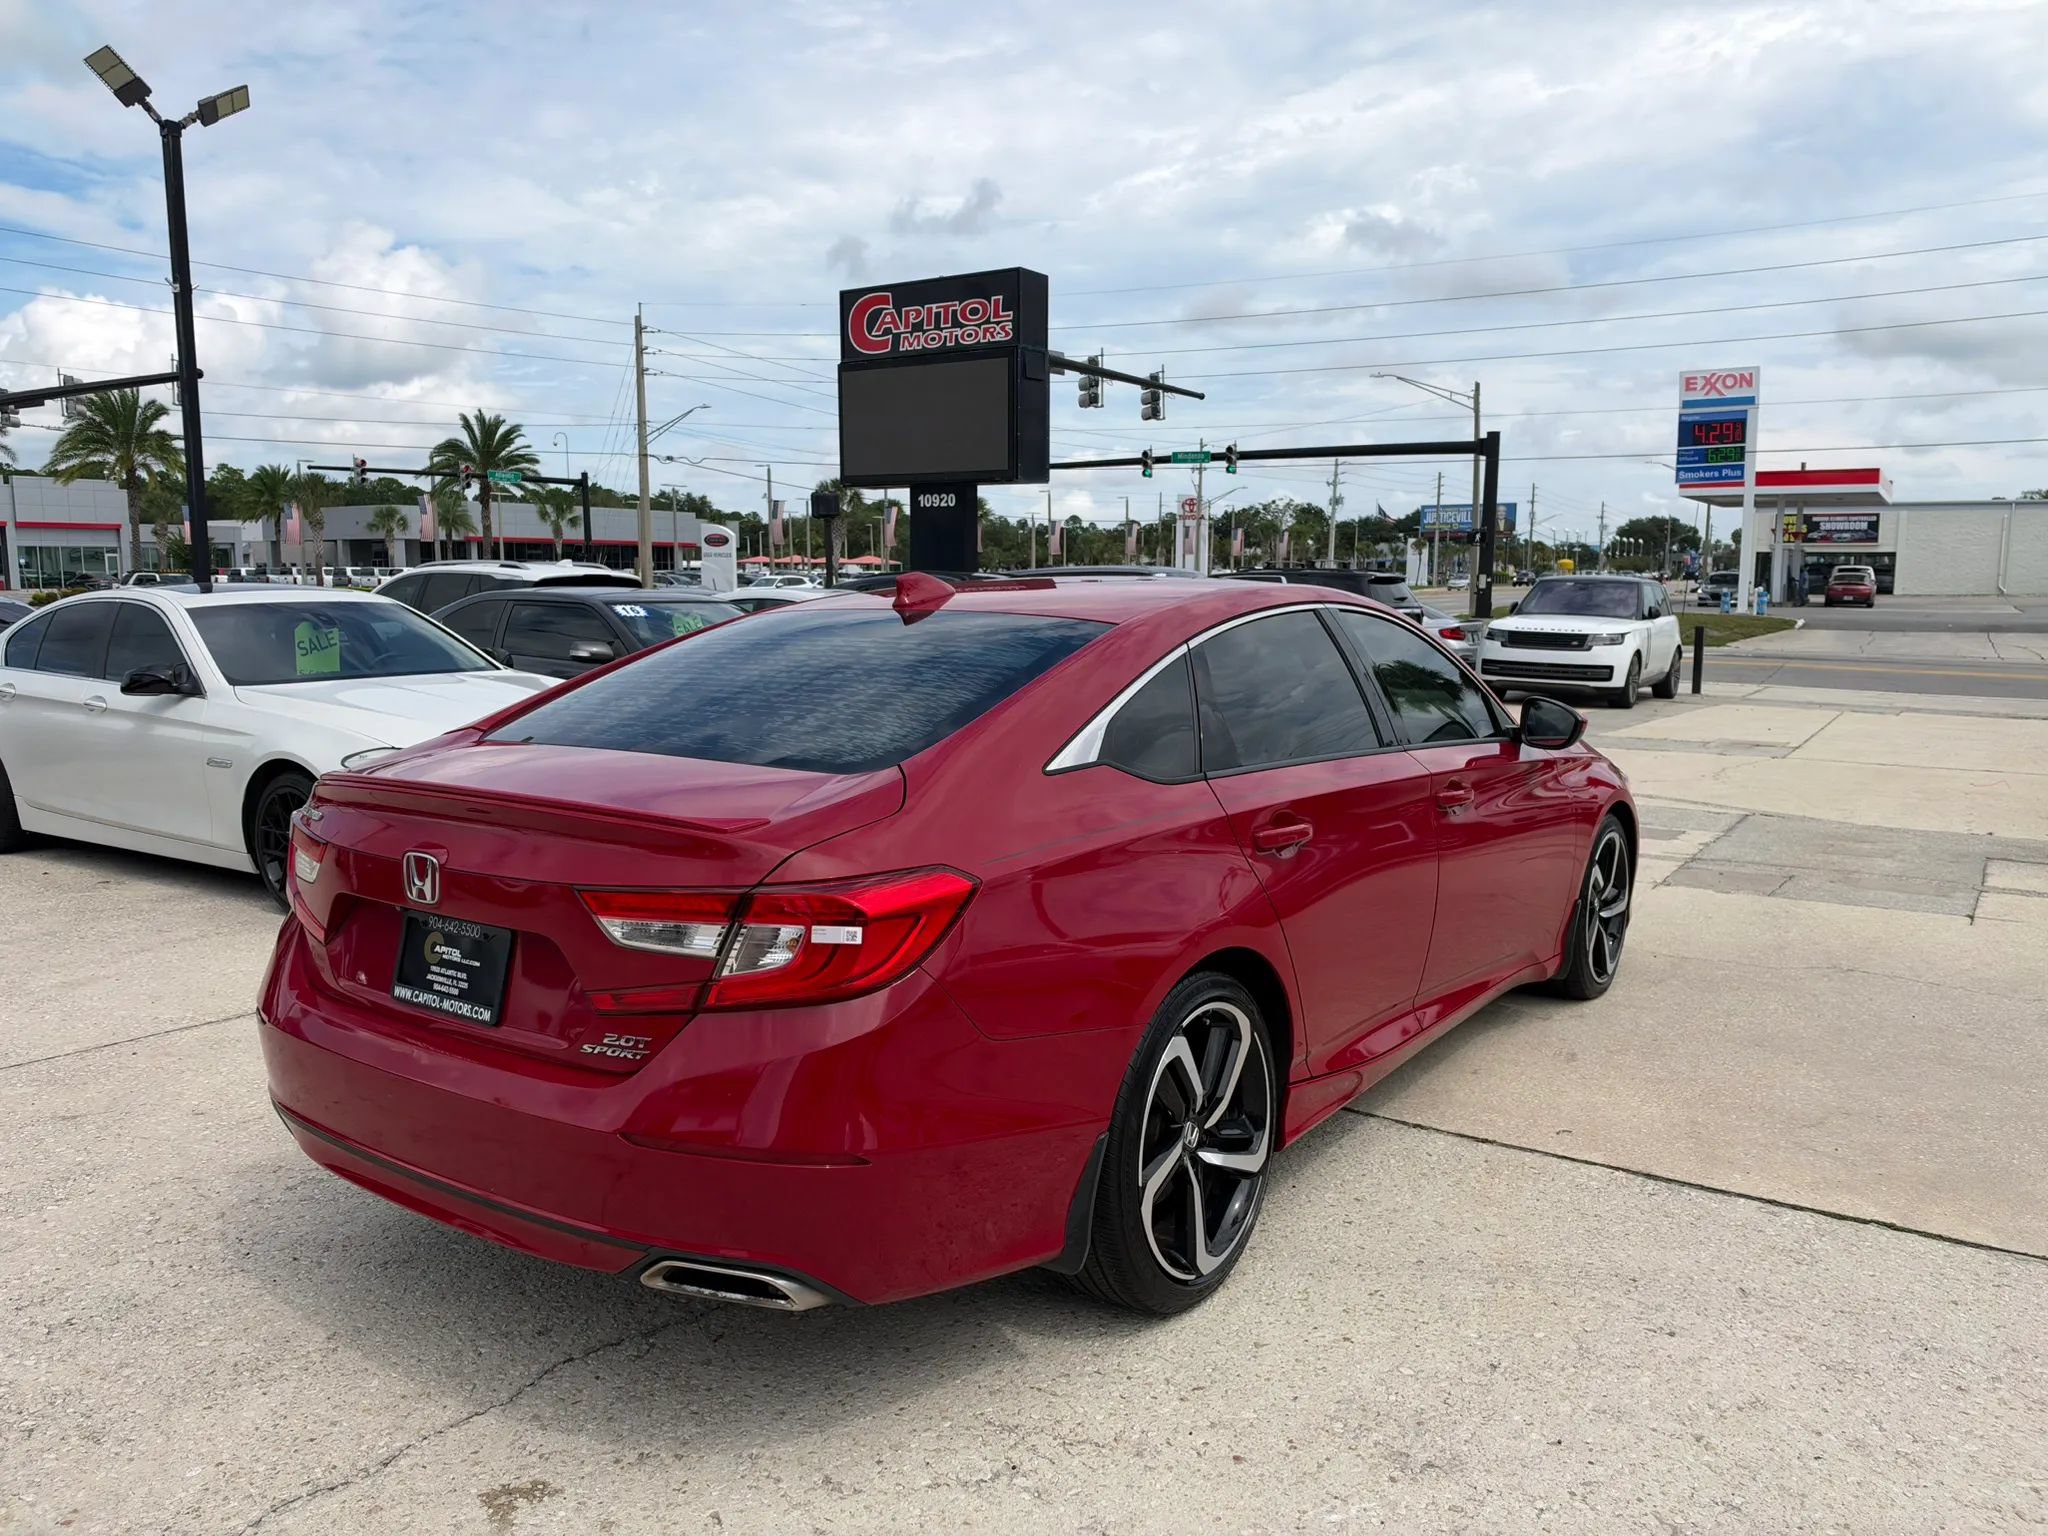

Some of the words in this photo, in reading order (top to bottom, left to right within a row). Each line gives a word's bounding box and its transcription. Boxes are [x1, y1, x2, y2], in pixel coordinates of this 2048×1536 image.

[848, 292, 1014, 354] CAPITOL
[899, 322, 1013, 351] MOTORS
[1684, 372, 1754, 396] EXXON
[1679, 470, 1719, 480] Smokers
[1722, 467, 1742, 477] Plus
[917, 493, 956, 508] 10920
[1820, 521, 1869, 530] SHOWROOM
[297, 630, 338, 657] SALE
[428, 916, 481, 938] 904-642-5500
[394, 985, 491, 1022] WWW.CAPITOL-MOTORS.COM
[580, 1043, 651, 1060] SPORT
